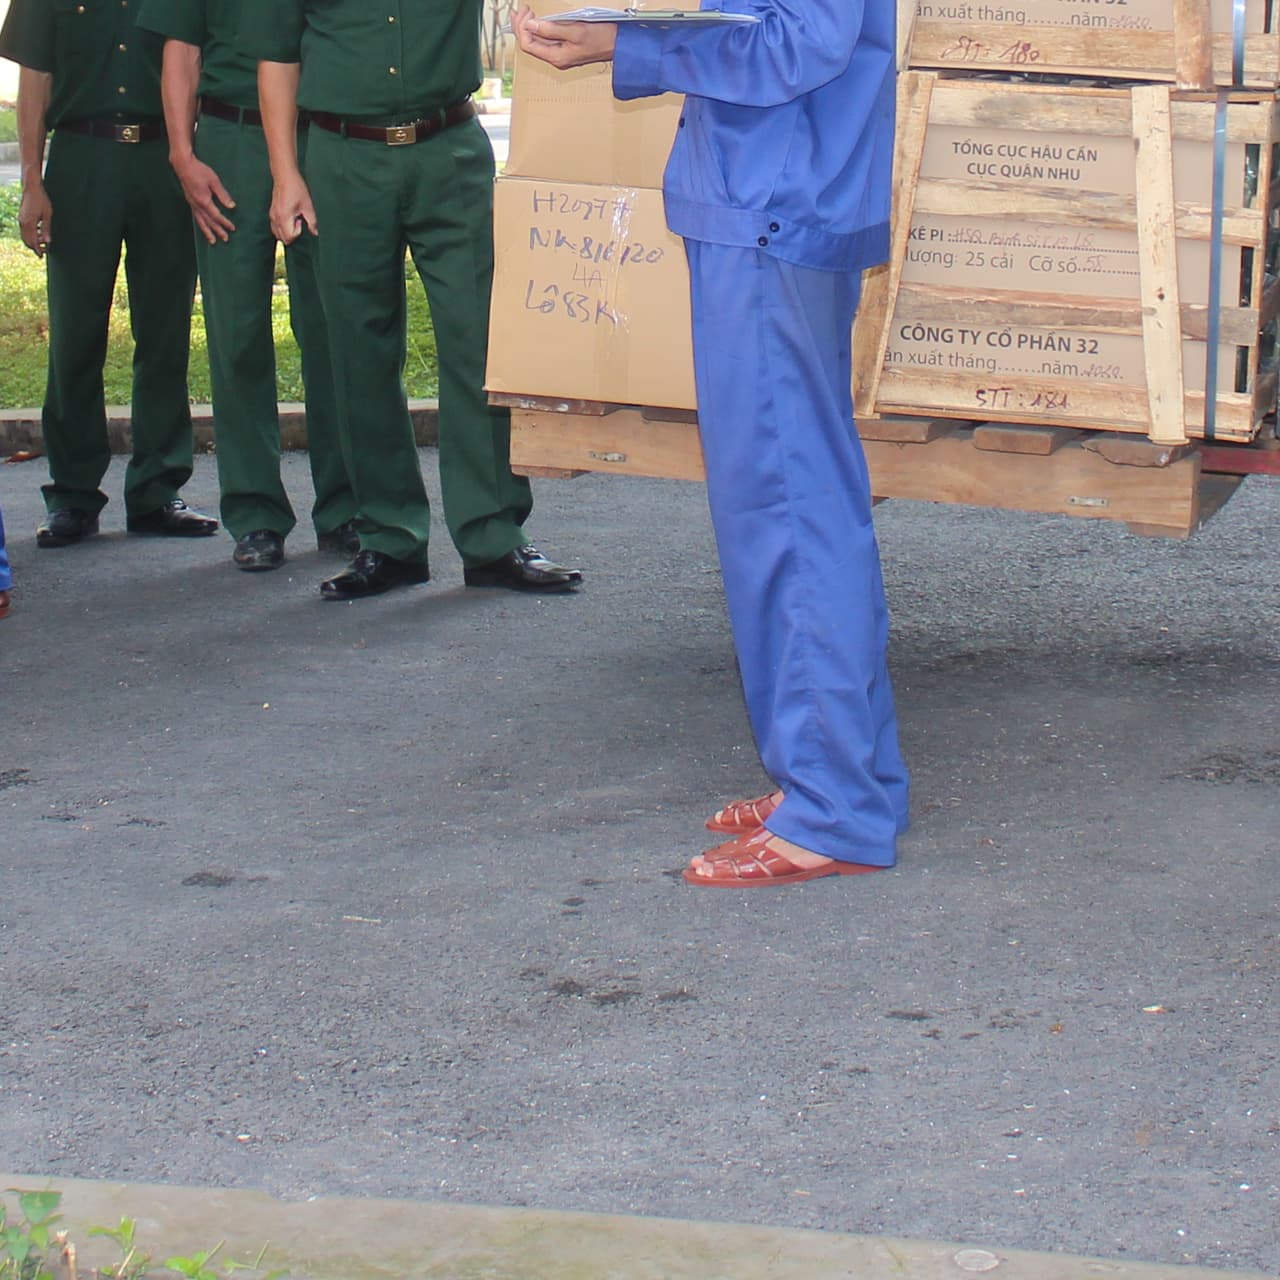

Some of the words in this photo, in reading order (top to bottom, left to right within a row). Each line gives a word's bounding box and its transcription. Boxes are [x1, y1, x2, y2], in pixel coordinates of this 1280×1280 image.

[938, 2, 973, 19] xuất
[952, 138, 993, 156] TỔNG
[997, 145, 1027, 161] CỤC
[1031, 145, 1062, 163] HẬU
[967, 162, 996, 179] CỤC
[1000, 163, 1044, 180] QUÂN
[1048, 167, 1081, 181] NHU
[965, 251, 985, 267] 25
[991, 252, 1014, 269] cái
[1029, 255, 1054, 272] Cỡ
[900, 322, 954, 344] CÔNG
[958, 329, 980, 345] TY
[986, 327, 1012, 348] CỔ
[1076, 339, 1099, 354] 32
[908, 348, 944, 366] xuất
[1031, 392, 1070, 409] 181
